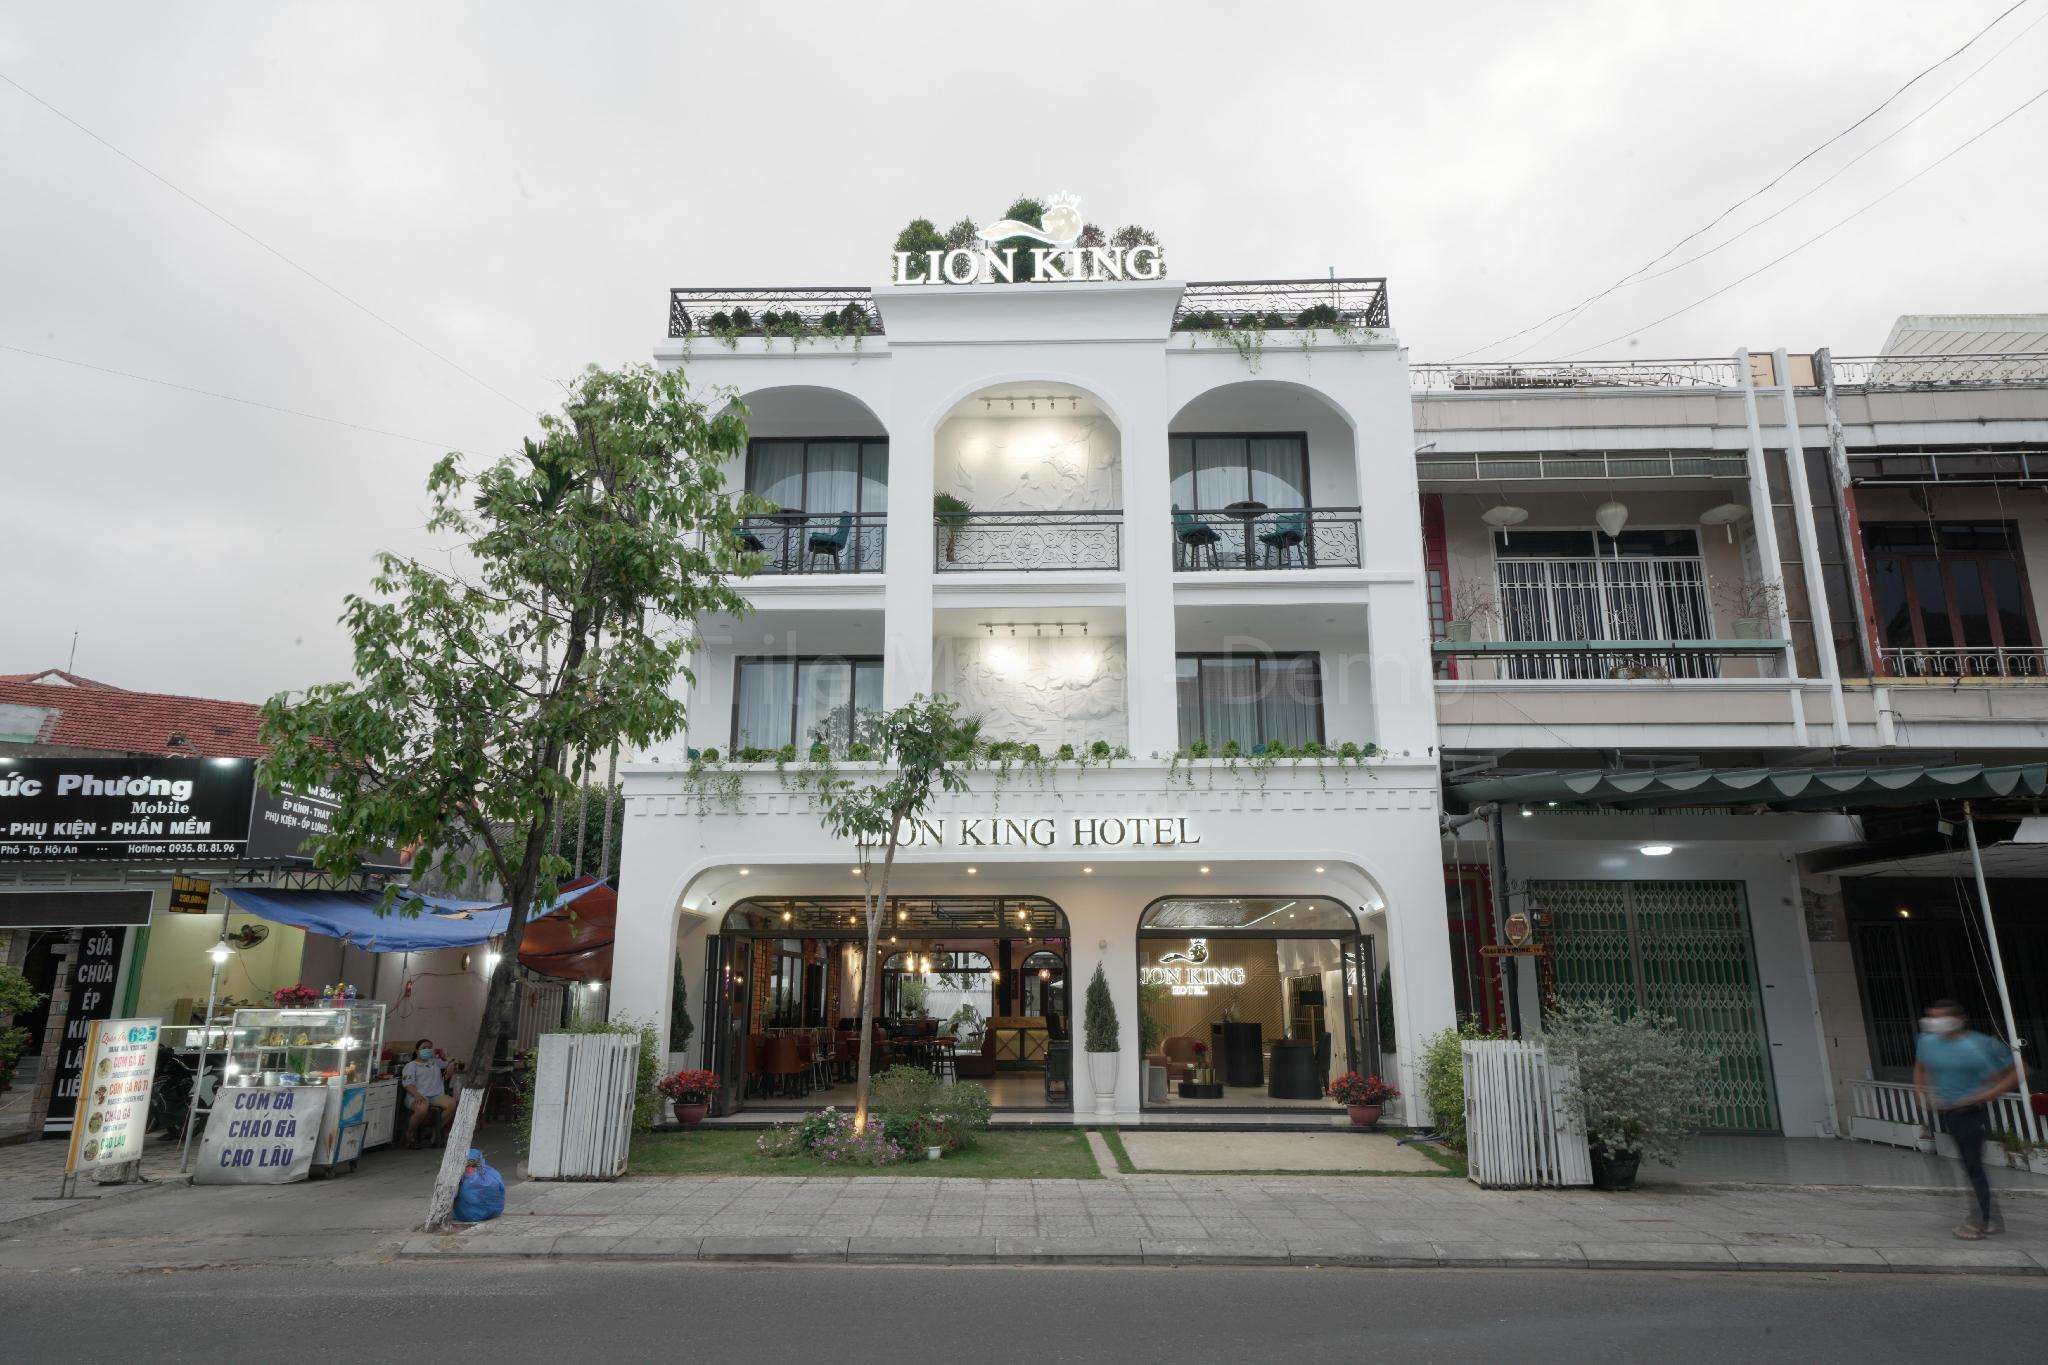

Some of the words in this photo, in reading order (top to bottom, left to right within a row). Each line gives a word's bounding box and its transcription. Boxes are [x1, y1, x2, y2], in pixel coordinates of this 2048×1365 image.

[894, 248, 1018, 285] LION
[1030, 244, 1164, 282] KING
[57, 774, 194, 801] Phương
[131, 802, 189, 814] Mobile
[10, 822, 47, 840] PHỤ
[53, 819, 97, 840] KIỆN
[111, 816, 163, 835] PHẦN
[170, 816, 211, 835] MỀM
[959, 818, 1056, 847] KING
[1073, 816, 1201, 847] HOTEL
[128, 844, 165, 853] Hotline:
[86, 930, 113, 956] SỬA
[78, 960, 113, 983] CHỮA
[1187, 967, 1245, 985] KING
[82, 987, 101, 1010] ÉP
[1172, 985, 1208, 995] HOTEL
[128, 1025, 158, 1044] 625
[274, 1113, 297, 1138] GÀ
[220, 1148, 254, 1168] CAO
